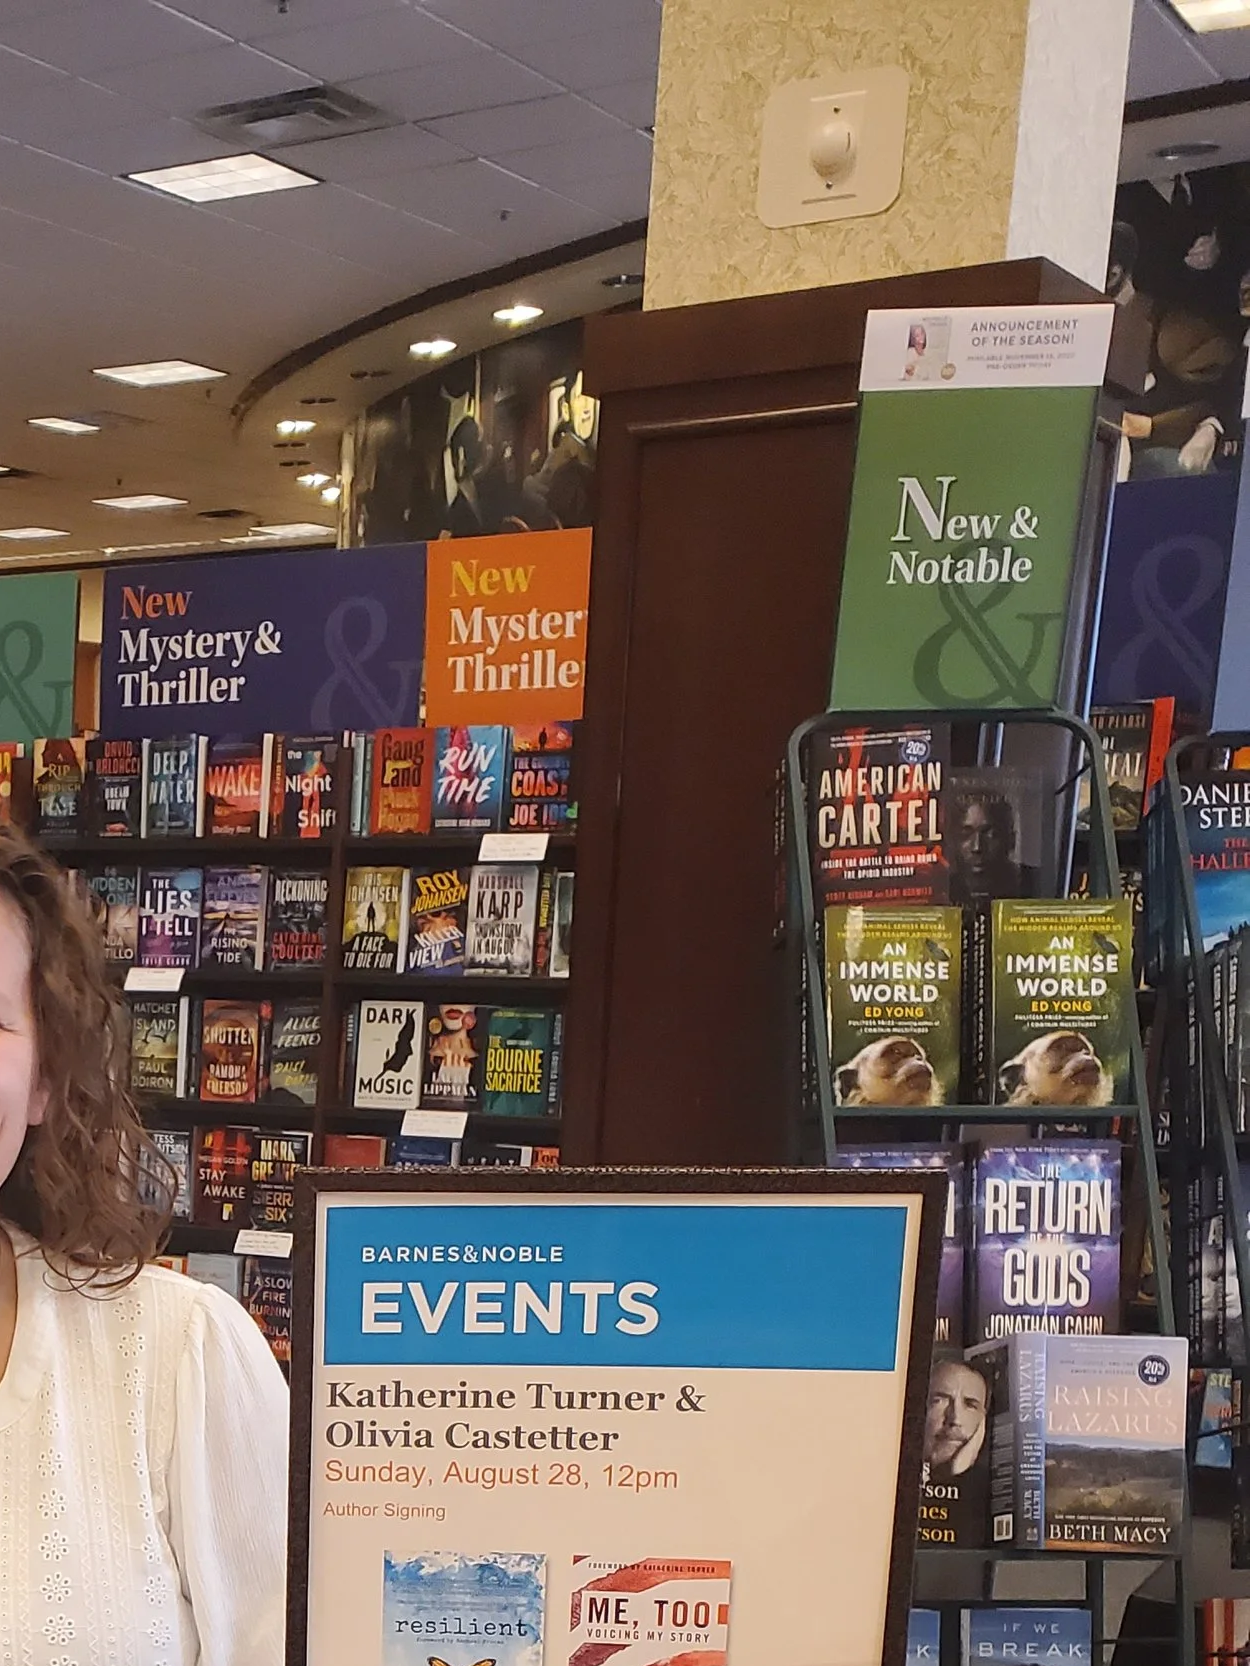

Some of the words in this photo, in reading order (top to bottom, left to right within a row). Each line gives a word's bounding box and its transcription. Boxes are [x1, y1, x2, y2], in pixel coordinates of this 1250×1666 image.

[971, 320, 1078, 332] ANNOUNCEMENT
[971, 336, 987, 346] OF
[992, 335, 1013, 345] THE
[1018, 334, 1074, 345] SEASON!
[891, 476, 1000, 542] New
[1009, 506, 1038, 539] &
[887, 547, 1032, 584] Notable
[450, 559, 536, 597] New
[121, 585, 192, 620] New
[448, 606, 586, 651] Myster
[447, 649, 586, 693] Thrille
[118, 667, 246, 708] Thriller
[439, 743, 497, 773] RUN
[208, 764, 260, 797] WAKE
[437, 775, 496, 804] TIME
[819, 762, 942, 800] AMERICAN
[818, 797, 942, 848] CARTEL
[415, 870, 460, 895] ROY
[144, 889, 192, 915] LIES
[476, 890, 524, 919] KARP
[156, 917, 193, 936] TELL
[211, 937, 248, 949] RISING
[882, 942, 907, 956] AN
[216, 951, 241, 963] TIDE
[840, 961, 949, 980] IMMENSE
[850, 984, 939, 1003] WORLD
[133, 1002, 177, 1014] HATCHET
[367, 1008, 417, 1024] DARK
[864, 1007, 881, 1017] ED
[885, 1007, 924, 1018] YONG
[134, 1018, 176, 1032] ISLAND
[139, 1062, 167, 1074] PAUL
[487, 1048, 543, 1073] BOURNE
[132, 1076, 174, 1089] DOIRON
[359, 1077, 413, 1095] MUSIC
[485, 1073, 542, 1094] SACRIFICE
[200, 1168, 226, 1182] STAY
[203, 1186, 246, 1199] AWAKE
[984, 1177, 1111, 1235] RETURN
[361, 1245, 563, 1263] BARNES&NOBLE
[1003, 1248, 1090, 1308] GODS
[361, 1282, 660, 1335] EVENTS
[326, 1381, 516, 1410] Katherine
[526, 1383, 664, 1411] Turner
[675, 1385, 706, 1412] &
[1053, 1385, 1173, 1407] RAISING
[1048, 1410, 1178, 1433] LAZARUS
[325, 1420, 433, 1449] Olivia
[446, 1422, 619, 1451] Castetter
[324, 1459, 433, 1487] Sunday,
[443, 1461, 539, 1488] August
[548, 1463, 589, 1489] 28,
[603, 1465, 678, 1492] 12pm
[323, 1503, 378, 1518] Author
[384, 1503, 446, 1521] Signing
[1049, 1523, 1106, 1541] BETH
[1113, 1524, 1171, 1543] MACY
[587, 1597, 640, 1628] ME,
[654, 1600, 710, 1628] TOO
[395, 1616, 528, 1638] resilient
[1002, 1623, 1022, 1634] IF
[1034, 1622, 1060, 1634] WE
[978, 1641, 1082, 1658] BREAK
